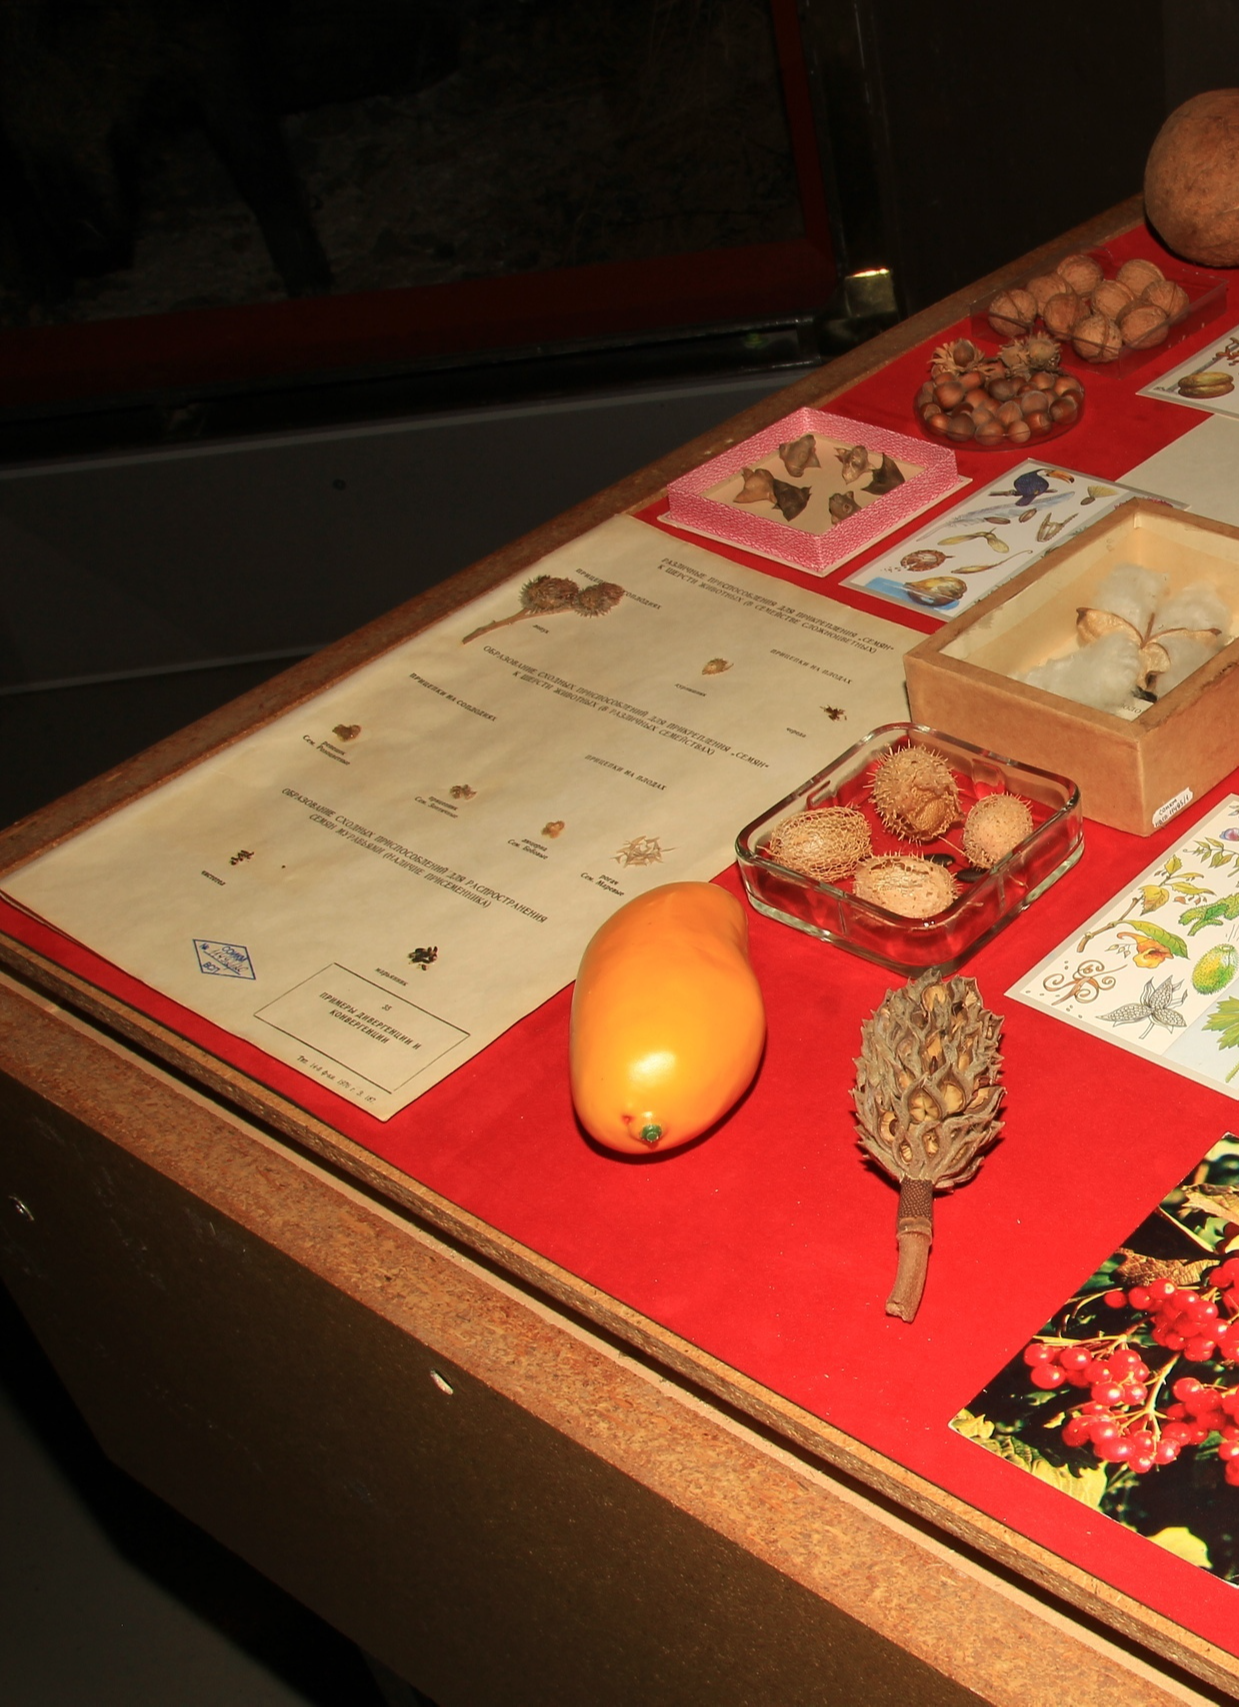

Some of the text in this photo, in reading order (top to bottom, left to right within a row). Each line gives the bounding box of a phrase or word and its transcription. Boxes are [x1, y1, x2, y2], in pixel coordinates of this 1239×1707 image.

[661, 557, 707, 580] РАЗЛИЧНЫЕ
[707, 576, 777, 607] ПРИСПОСОБЛЕНИЯ
[777, 605, 796, 615] ДЛЯ
[795, 611, 858, 638] ПРИКРЕПЛЕНИЯ
[665, 567, 698, 585] ШЕРСТИ
[698, 581, 744, 603] ЖИВОТНЫХ
[754, 604, 800, 625] СЕМЕЙСТВЕ
[770, 648, 853, 685] ПРИЦЕПКИ НА ПЛОДАХ
[409, 672, 497, 722] ПРИЦЕПКИ НА СОПЛОДИЯХ
[483, 645, 538, 675] ОБРАЗОВАНИЕ
[537, 671, 577, 691] СХОДНЫХ
[576, 687, 649, 718] ПРИСПОСОБЛЕНИЙ
[648, 716, 667, 726] ДЛЯ
[666, 722, 732, 752] ПРИКРЕПЛЕНИЯ
[520, 673, 554, 691] ШЕРСТИ
[553, 687, 599, 708] ЖИВОТНЫХ
[609, 708, 658, 732] РАЗЛИЧНЫХ
[658, 729, 716, 756] СЕМЕЙСТВАХ)
[584, 754, 667, 791] ПРИЦЕПКИ НА ПЛОДАХ
[281, 787, 548, 923] ОБРАЗОВАНИЕ СХОДНЫХ ПРИСПОСОБЛЕНИЙ ДЛЯ РАСПРОСТРАНЕНИЯ
[309, 813, 493, 908] СЕМЯН МУРАВЬЯМИ (НАЛИЧИЕ ПРИСЕМЕННИКА)
[319, 991, 358, 1014] ПРИМЕРЫ
[355, 1010, 414, 1046] ДИВЕРГЕНЦИИ
[329, 1008, 390, 1044] КОНВЕРГЕНЦИИ
